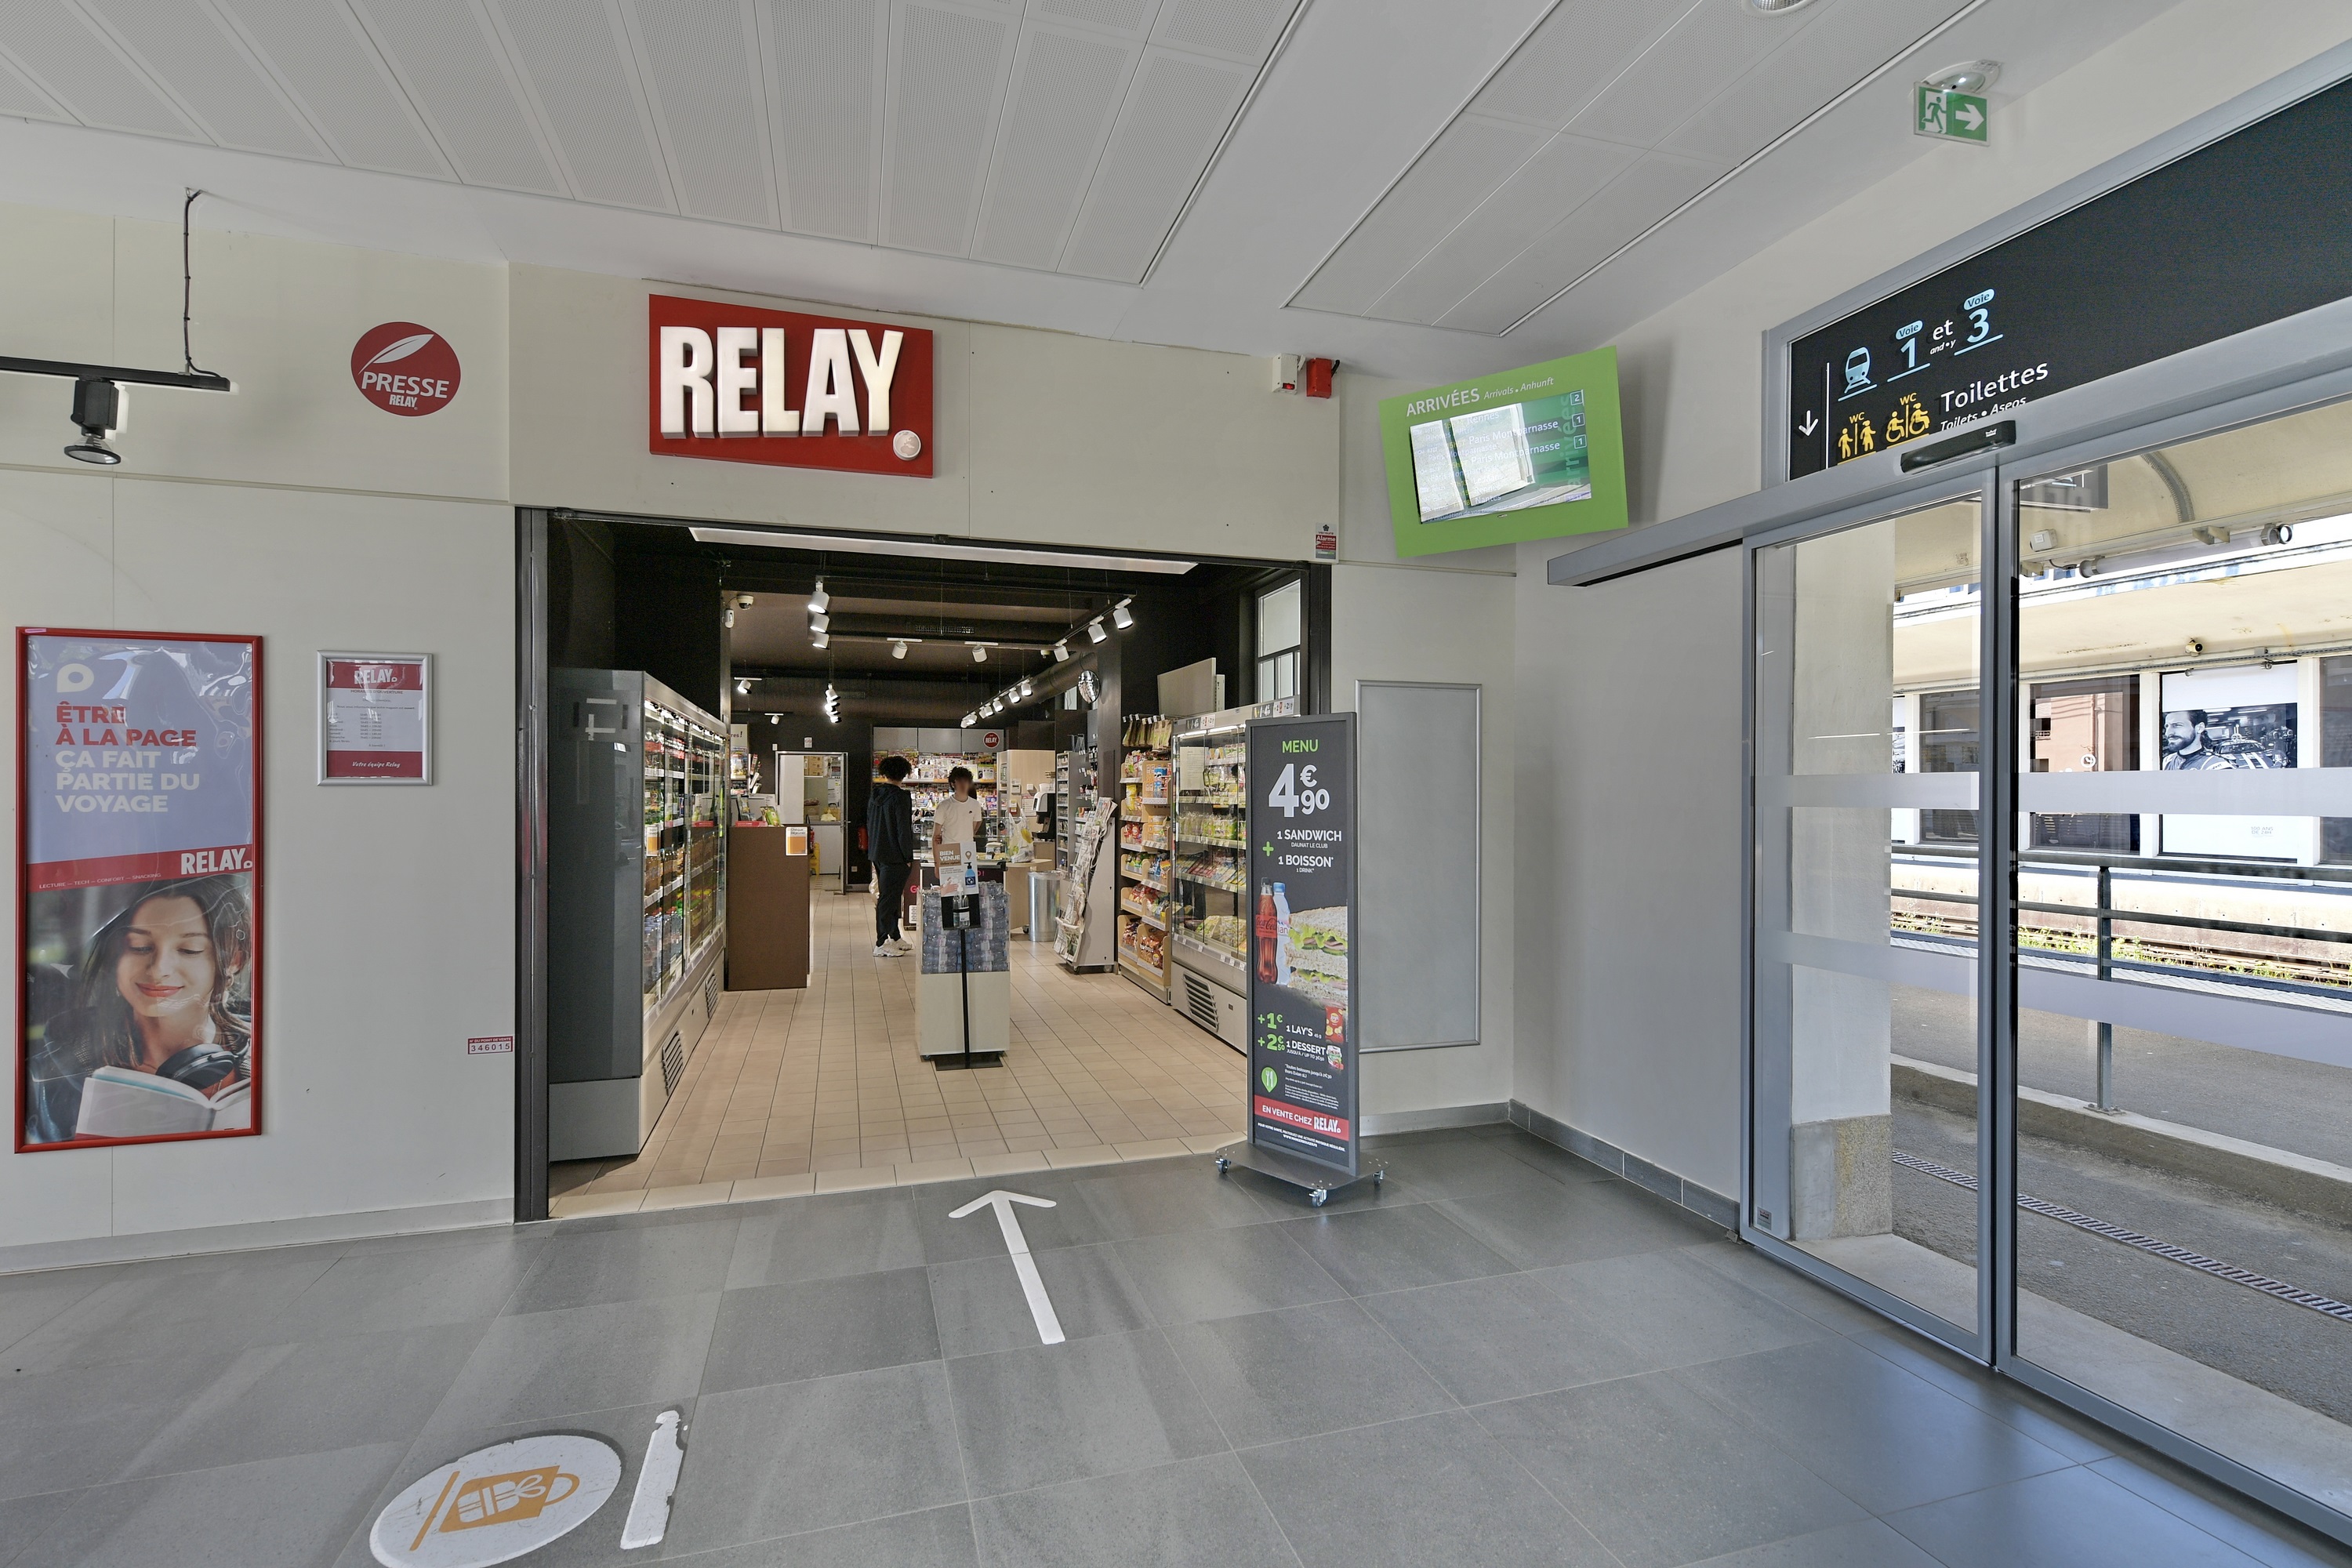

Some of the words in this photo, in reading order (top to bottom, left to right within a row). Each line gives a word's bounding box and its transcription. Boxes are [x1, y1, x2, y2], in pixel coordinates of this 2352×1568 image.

[1968, 292, 1991, 307] Voie
[1900, 322, 1918, 336] Voie
[1900, 337, 1916, 368] 1
[1933, 319, 1953, 341] et
[1967, 308, 1990, 343] 3
[361, 371, 449, 398] PRESSE
[1940, 362, 2049, 412] Toilettes
[1406, 387, 1480, 417] ARRIVÉES
[1483, 386, 1514, 400] Arrivals
[1520, 376, 1554, 392] Anhunft
[1900, 392, 1918, 404] WC
[1849, 412, 1865, 423] WC
[1940, 412, 1978, 431] Toilets
[1990, 397, 2027, 416] Aseos
[1468, 434, 1490, 445] Paris
[1492, 421, 1559, 440] Montparnasse
[1471, 454, 1492, 465] Paris
[1494, 441, 1560, 461] Montparnasse
[56, 701, 127, 724] ÊTRE
[56, 724, 75, 746] À
[83, 728, 119, 746] LA
[126, 729, 197, 747] PAGE
[1282, 739, 1319, 753] MENU
[55, 750, 96, 772] ÇA
[103, 750, 162, 768] FAIT
[56, 773, 154, 790] PARTIE
[161, 773, 200, 790] DU
[55, 795, 169, 813] VOYAGE
[1277, 830, 1283, 840] 1
[1284, 829, 1342, 842] SANDWICH
[1278, 856, 1283, 865] 1
[1291, 1025, 1313, 1036] LAY'S
[1291, 1040, 1327, 1055] DESSERT
[1262, 1105, 1272, 1114] EN
[1272, 1107, 1294, 1120] VENTE
[1294, 1114, 1312, 1126] CHEZ
